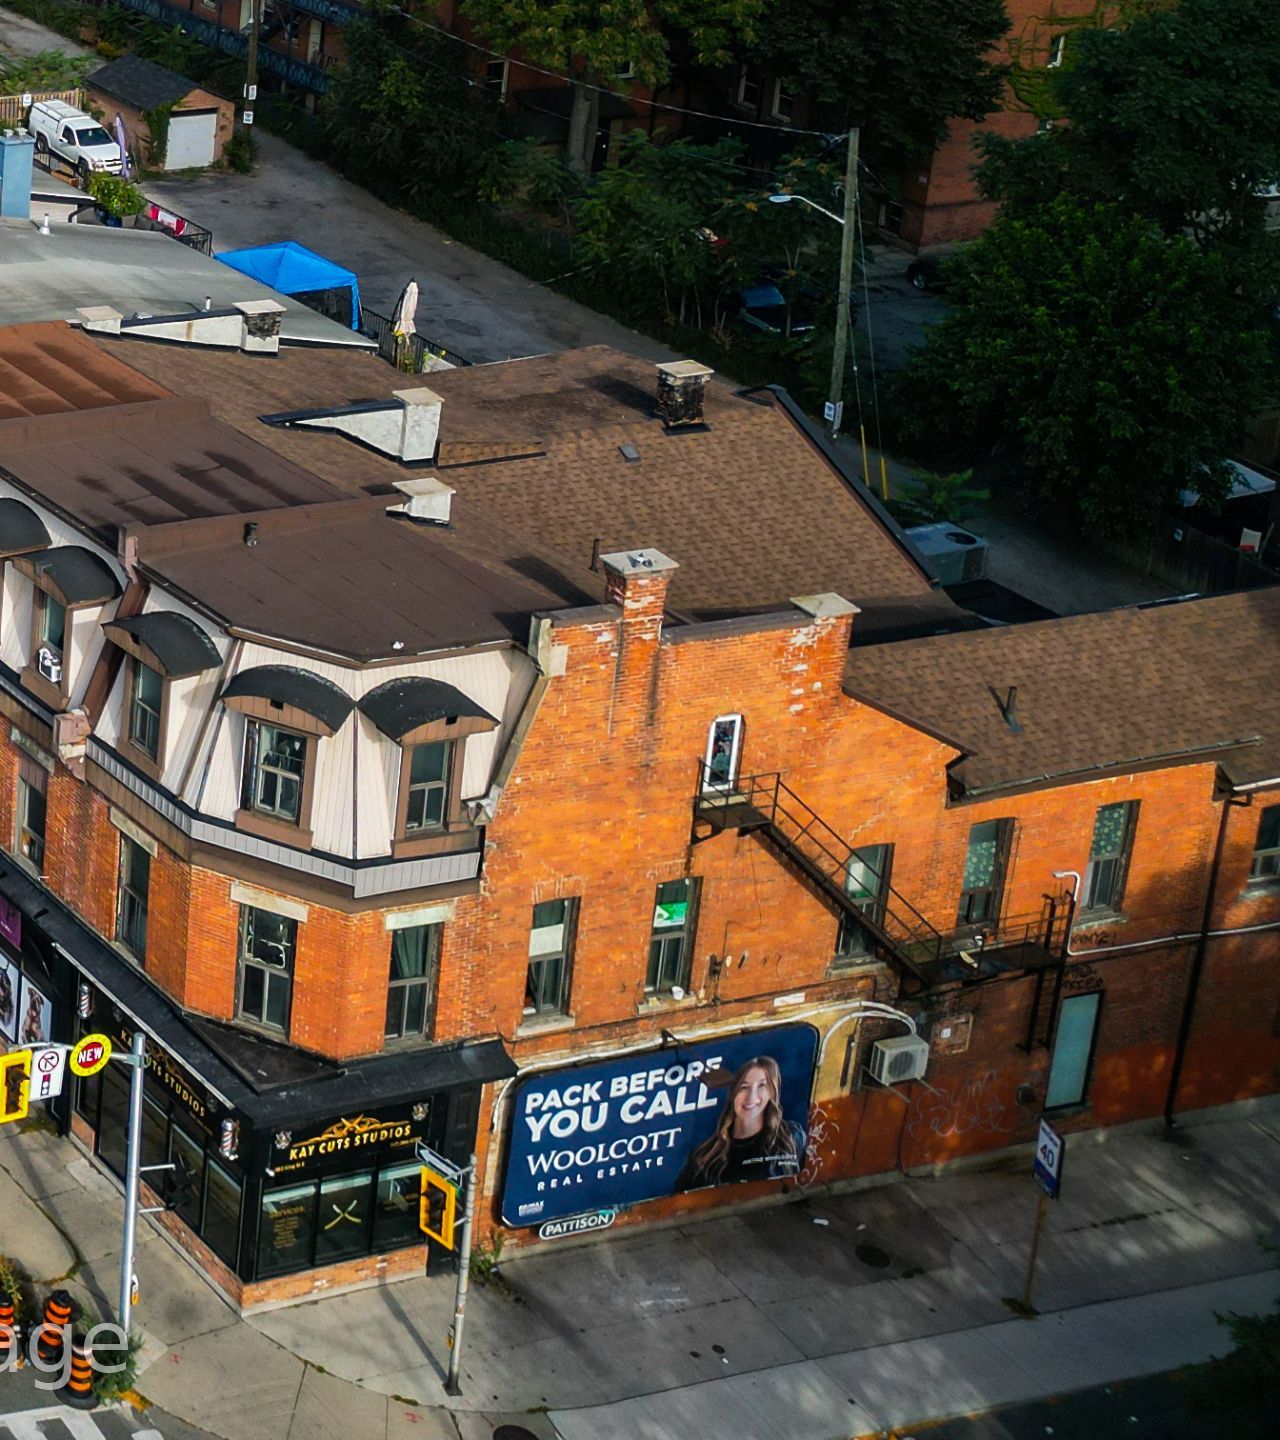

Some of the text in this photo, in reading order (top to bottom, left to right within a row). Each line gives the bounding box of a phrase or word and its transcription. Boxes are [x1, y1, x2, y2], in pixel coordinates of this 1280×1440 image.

[78, 1045, 104, 1063] NEW
[120, 1029, 132, 1047] KA
[164, 1072, 205, 1117] STUDIOS
[525, 1056, 723, 1114] PACK BEFORE
[525, 1083, 718, 1142] YOU CALL
[290, 1145, 315, 1160] KAY
[319, 1138, 351, 1154] CUTS
[354, 1125, 412, 1146] STUDIOS
[526, 1127, 682, 1176] WOOLCOTT
[1040, 1144, 1055, 1168] 40
[537, 1156, 664, 1191] REAL ESTATE
[545, 1214, 610, 1236] PATTISON
